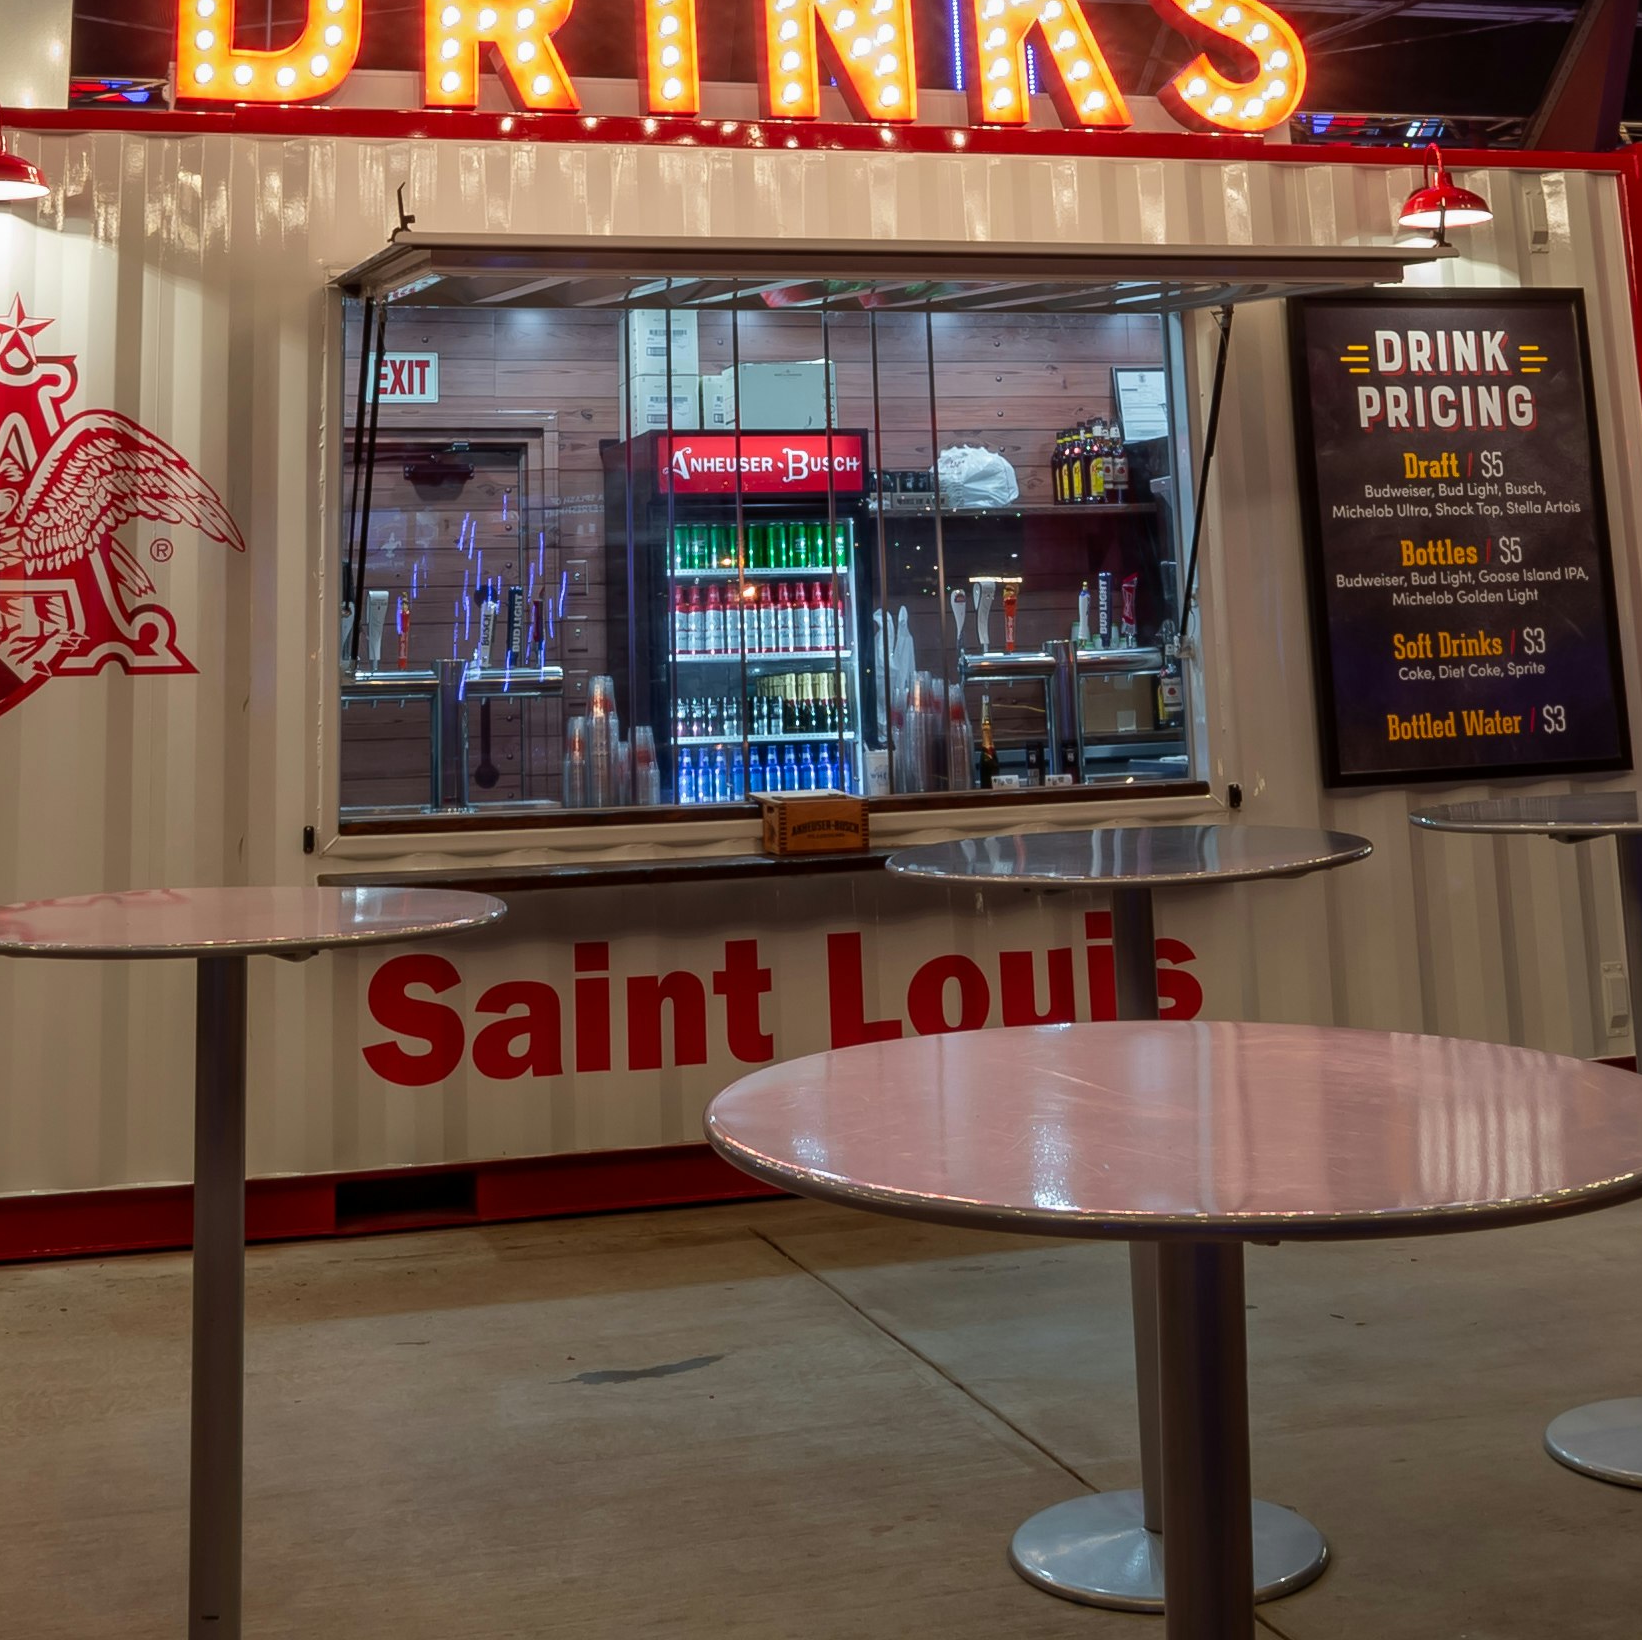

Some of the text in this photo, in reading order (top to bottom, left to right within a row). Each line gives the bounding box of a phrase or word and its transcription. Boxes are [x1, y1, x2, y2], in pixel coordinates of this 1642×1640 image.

[1374, 330, 1512, 375] DRINK
[378, 360, 430, 394] EXIT
[1357, 385, 1537, 432] PRICING
[1403, 452, 1459, 479] Draft
[1480, 450, 1504, 478] $5
[1365, 481, 1546, 499] Budweiser, Bud Light, Busch,
[1333, 500, 1581, 518] Michelob Ultra, Shock Top, Stella Artois
[1400, 539, 1478, 566] Bottles
[1499, 536, 1523, 564] $5
[1336, 566, 1589, 588] Budweiser, Bud Light, Goose Island IPA,
[1392, 588, 1539, 606] Michelob Golden Light
[512, 594, 523, 653] BUD LIGHT
[1100, 617, 1108, 635] BUD
[1393, 632, 1433, 660] Soft
[1438, 630, 1503, 658] Drinks
[1523, 627, 1546, 655] $3
[1398, 662, 1546, 681] Coke, Diet Coke, Sprite
[1387, 712, 1457, 741] Bottled
[1461, 710, 1522, 736] Water
[1542, 704, 1566, 734] $3
[361, 910, 1205, 1087] Saint Louis
